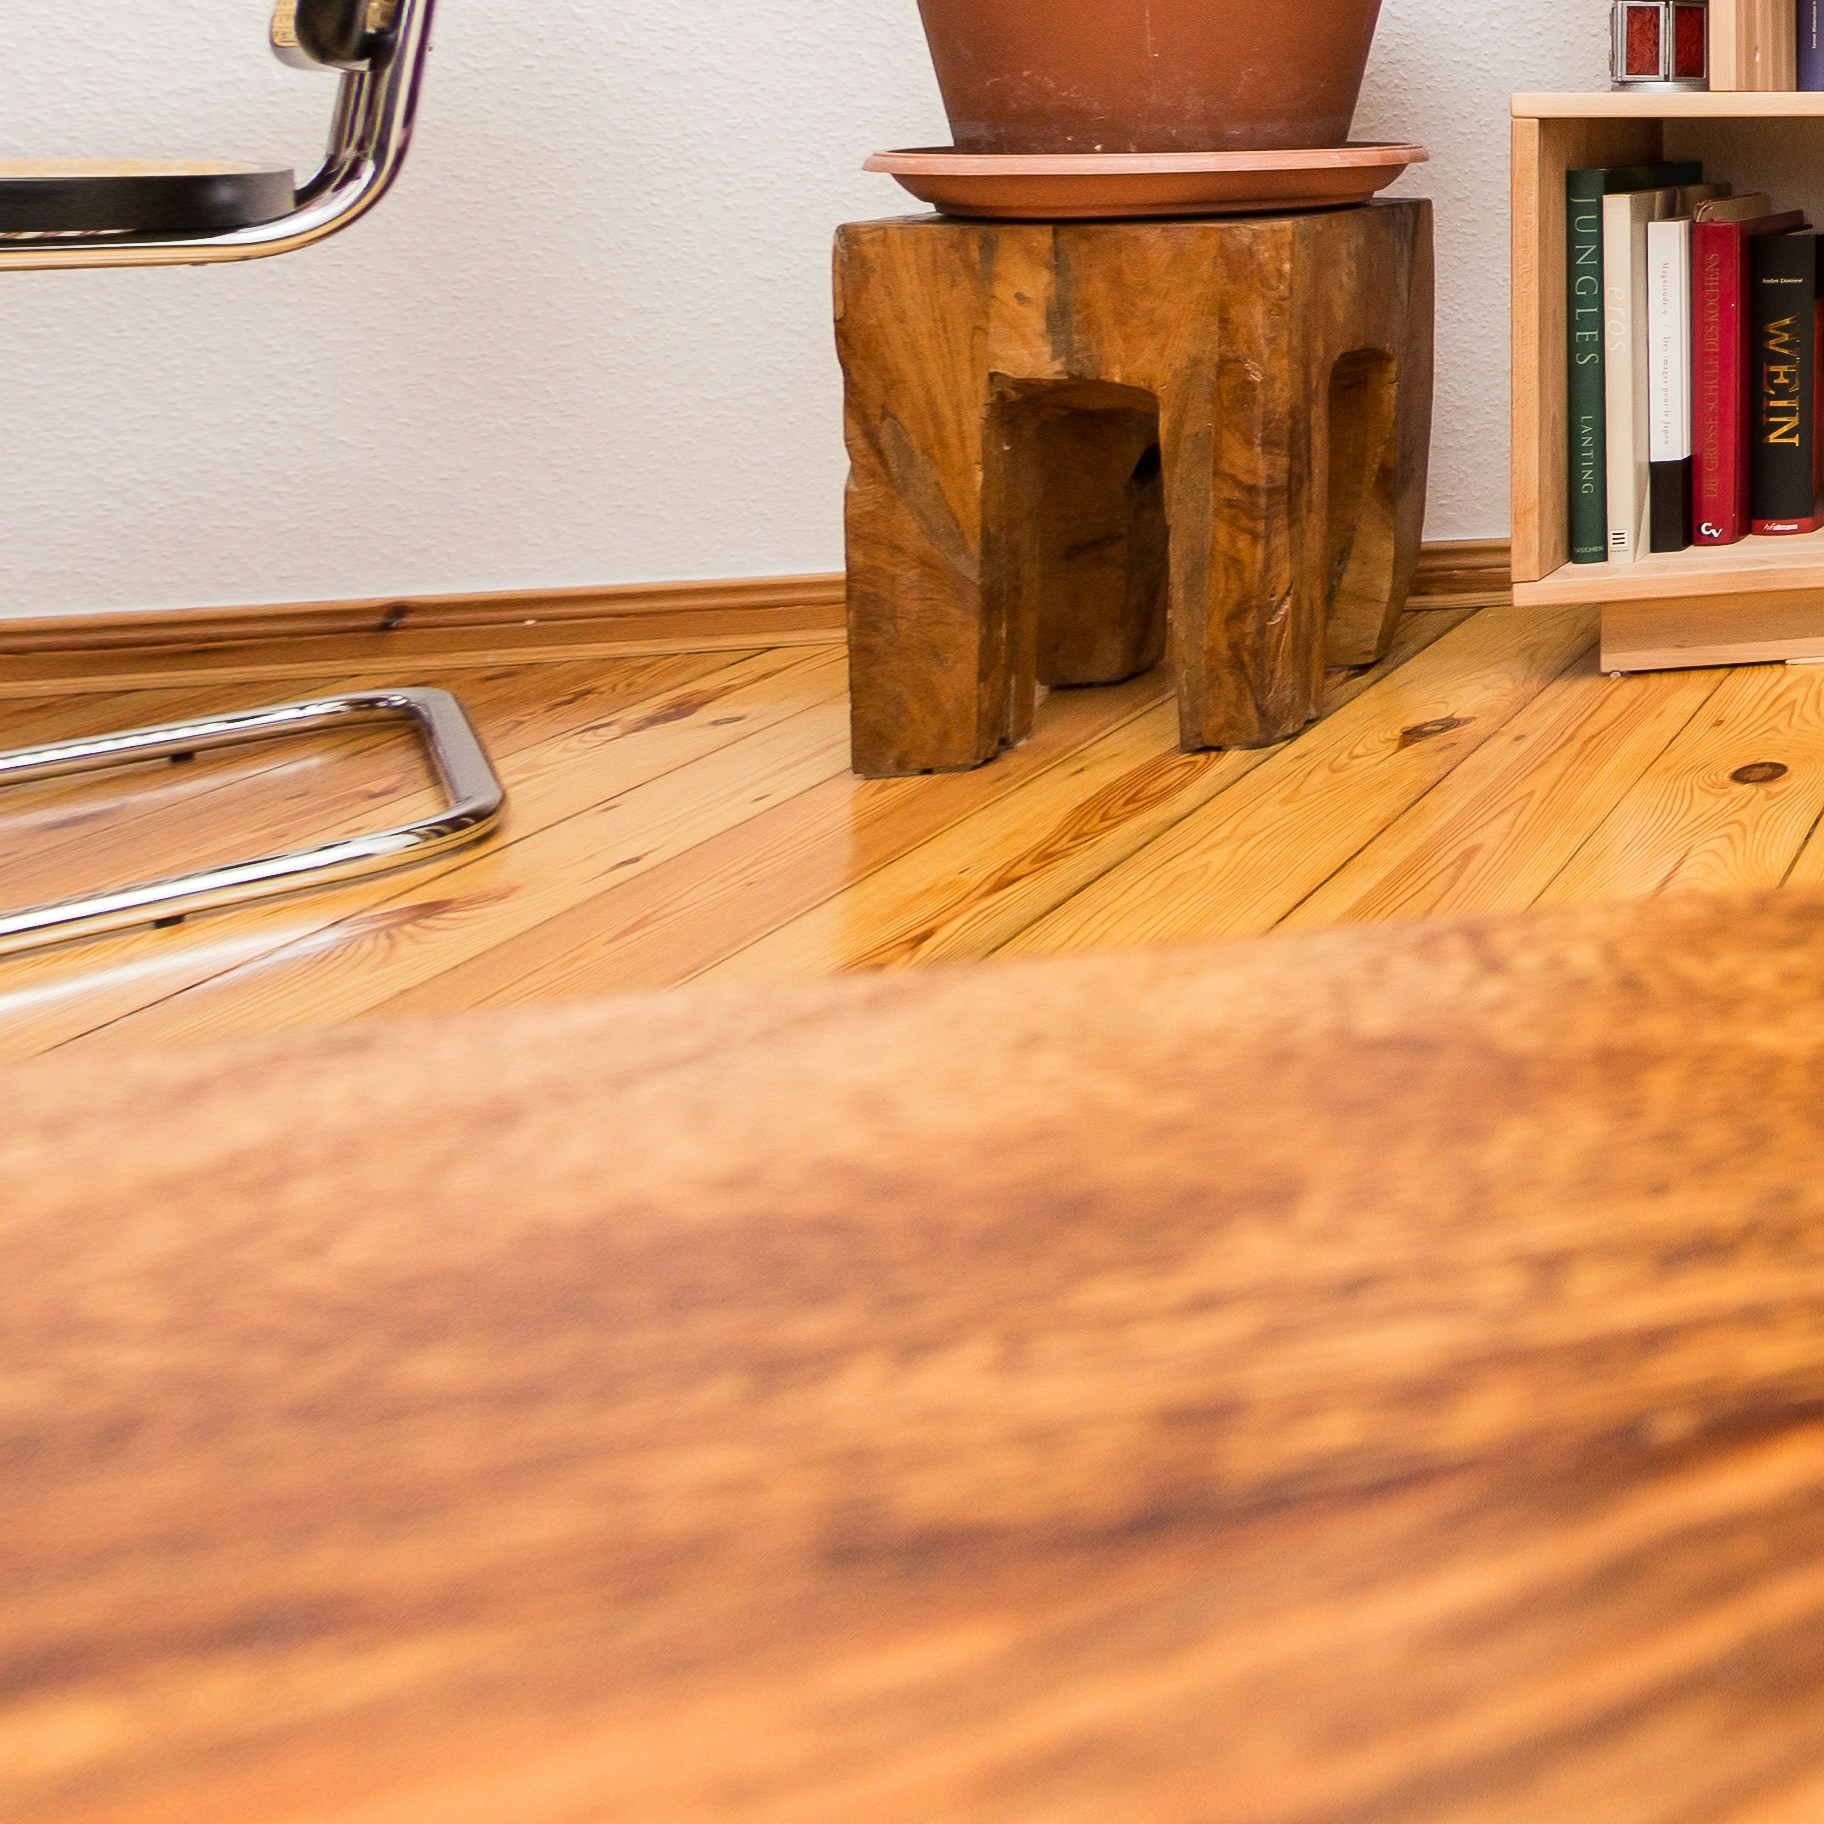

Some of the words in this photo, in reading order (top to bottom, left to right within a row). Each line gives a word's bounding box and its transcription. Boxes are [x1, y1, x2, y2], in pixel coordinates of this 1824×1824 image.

[1570, 197, 1601, 367] JUNGLES
[1660, 261, 1670, 306] Magnitude
[1704, 252, 1720, 322] KOCHENS
[1607, 285, 1632, 353] eros
[1704, 325, 1720, 352] DES
[1660, 355, 1671, 382] images
[1662, 335, 1671, 353] Des
[1660, 383, 1671, 408] pour
[1703, 358, 1719, 412] SCHULE
[1763, 313, 1800, 447] WEIN
[1579, 415, 1595, 495] LANTING
[1661, 419, 1672, 447] Japon
[1703, 418, 1719, 471] GROSSE
[1703, 478, 1719, 499] DIE
